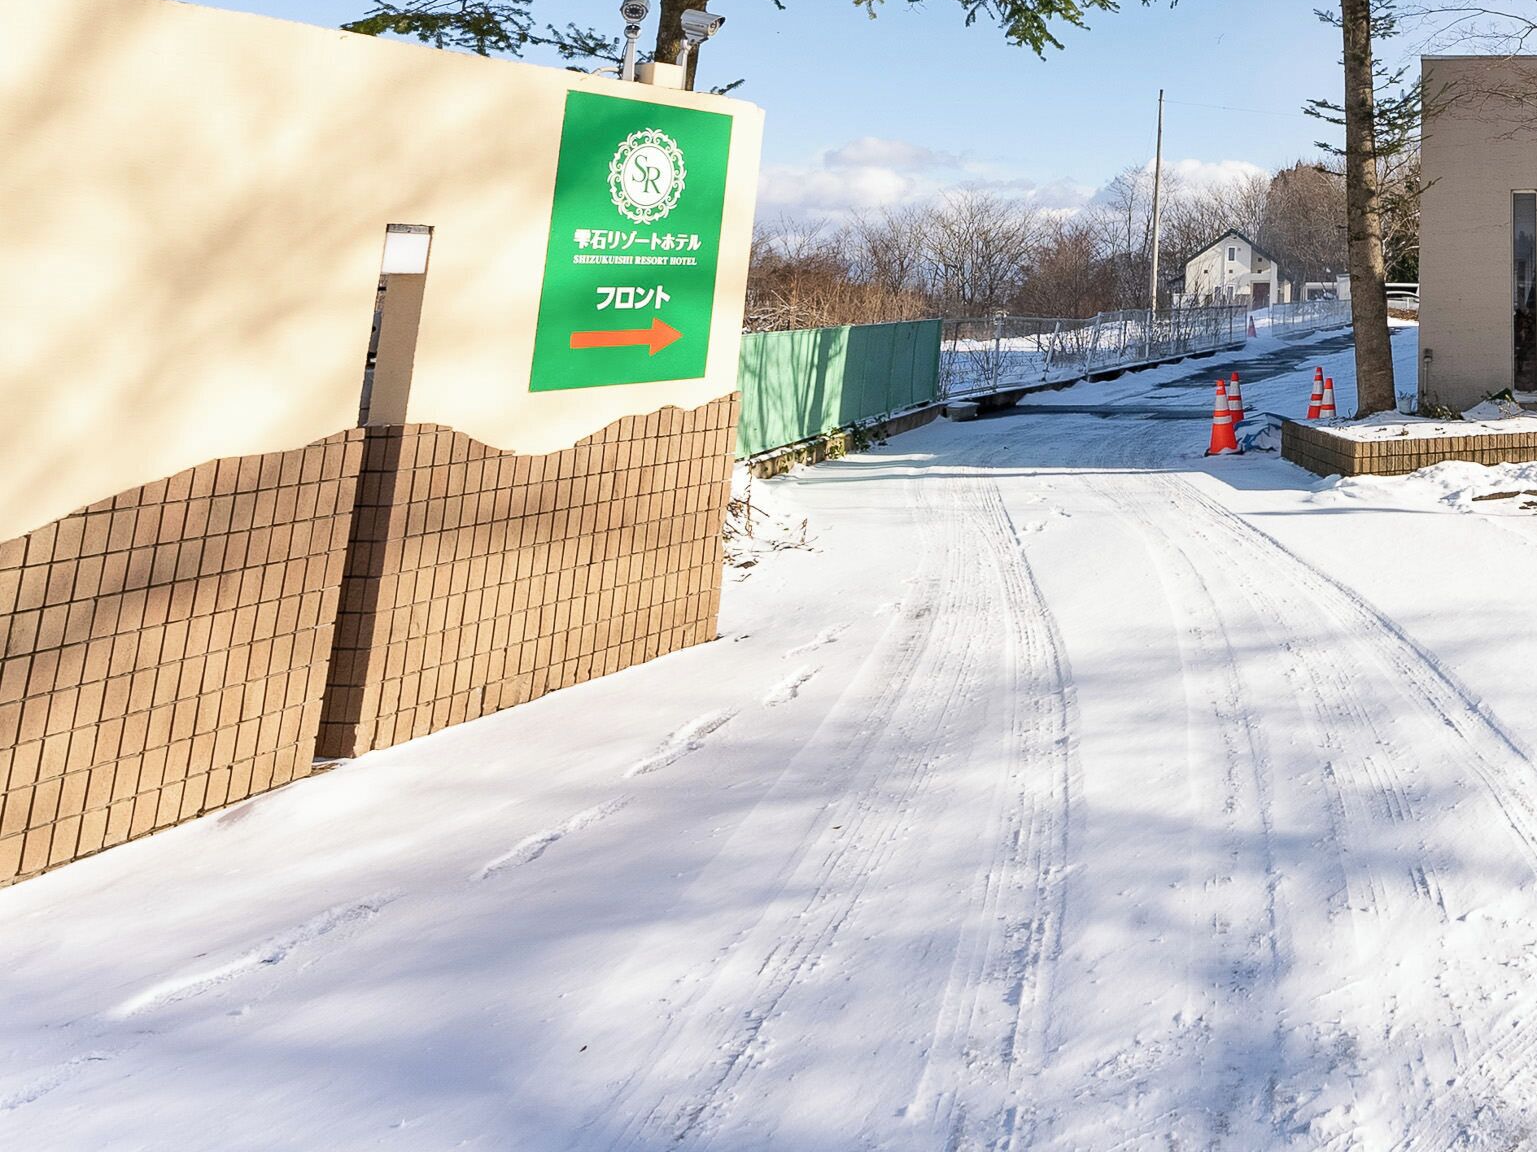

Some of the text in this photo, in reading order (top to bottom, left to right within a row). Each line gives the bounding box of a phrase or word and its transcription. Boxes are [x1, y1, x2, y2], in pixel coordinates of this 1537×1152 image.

[632, 154, 661, 194] SR
[573, 229, 702, 250] 雫石リゾートホテル
[573, 255, 698, 266] SHIZUKUISHI RESORT HOTEL
[596, 285, 671, 311] フロント
